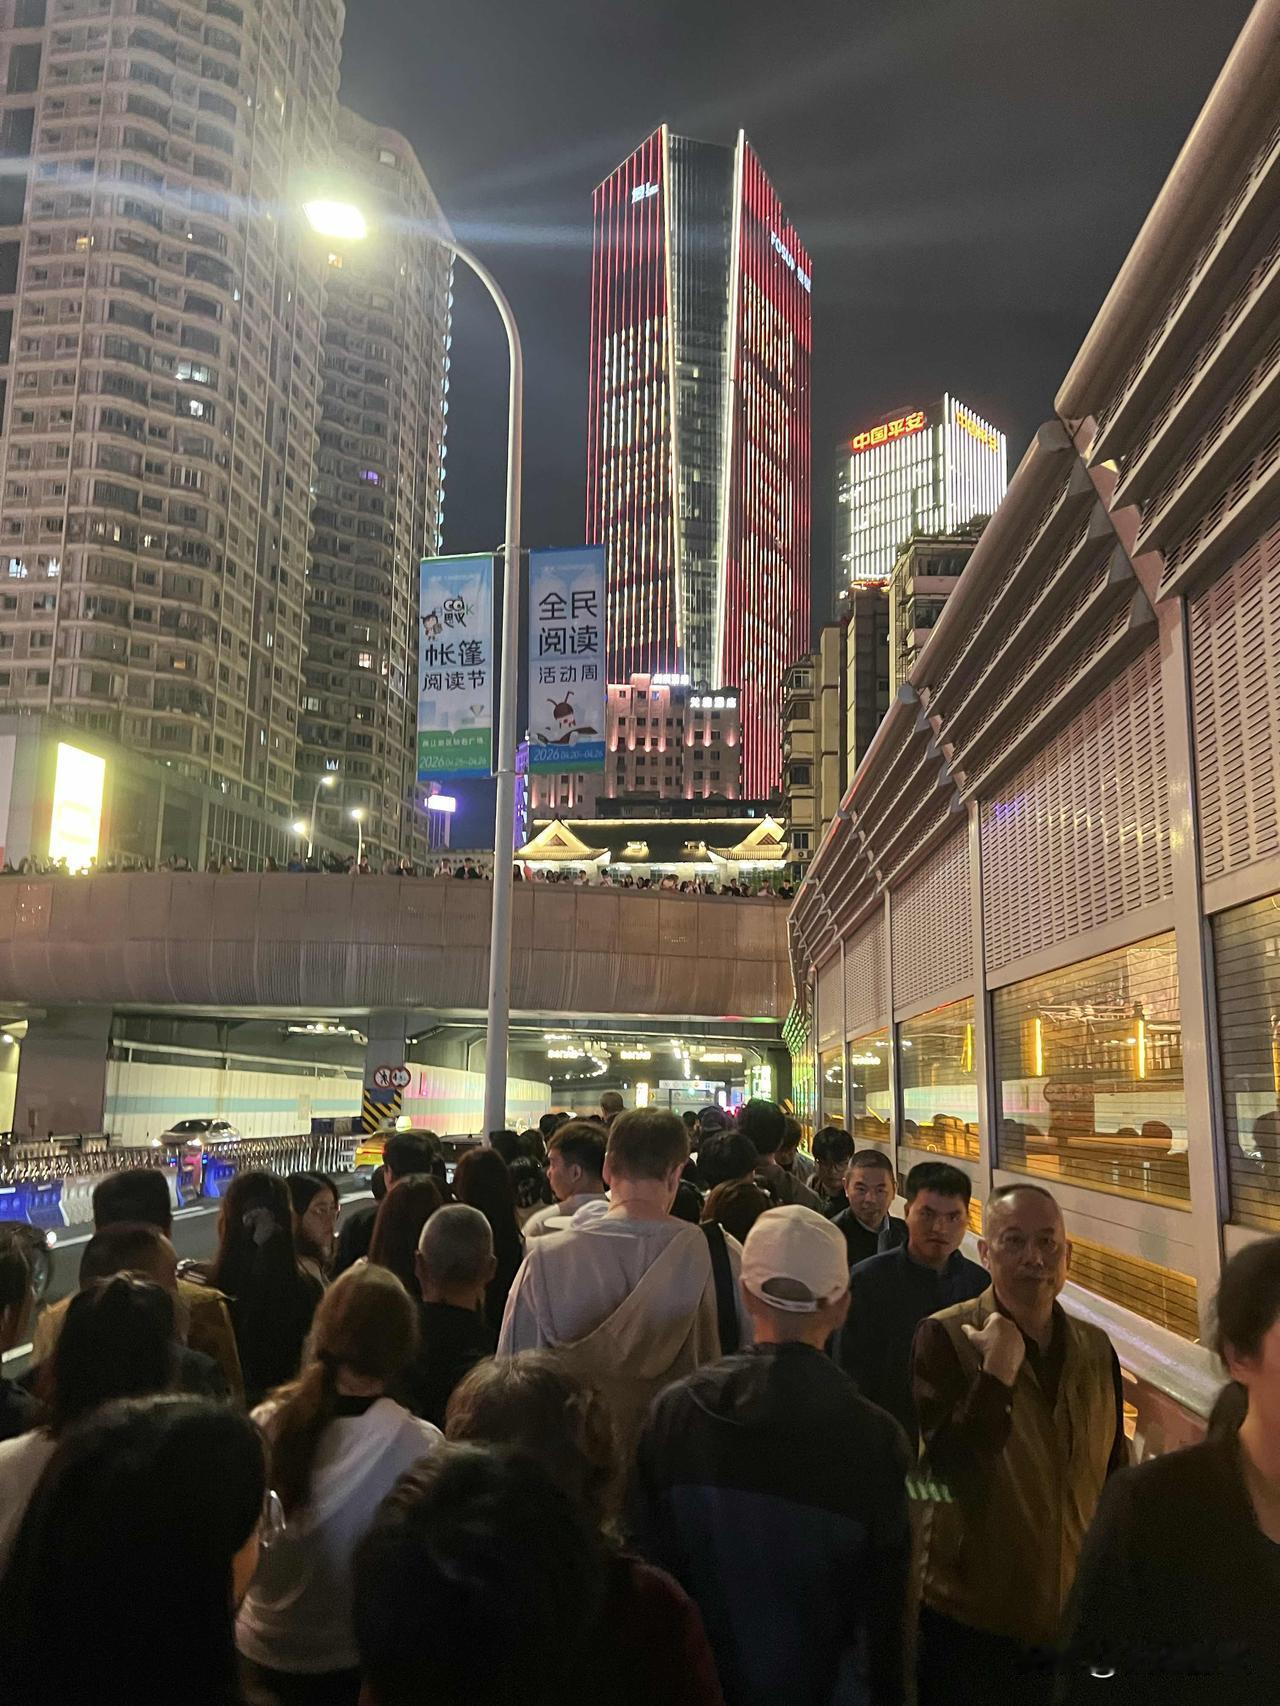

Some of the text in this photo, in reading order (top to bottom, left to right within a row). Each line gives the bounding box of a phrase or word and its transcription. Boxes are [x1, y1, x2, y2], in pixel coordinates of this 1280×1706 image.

[852, 411, 925, 450] 中国平安
[538, 590, 598, 621] 全民
[424, 640, 485, 667] 帐篷
[538, 625, 598, 656] 阅读
[422, 669, 485, 691] 阅读节
[538, 663, 598, 684] 活动周
[533, 747, 560, 761] 2026
